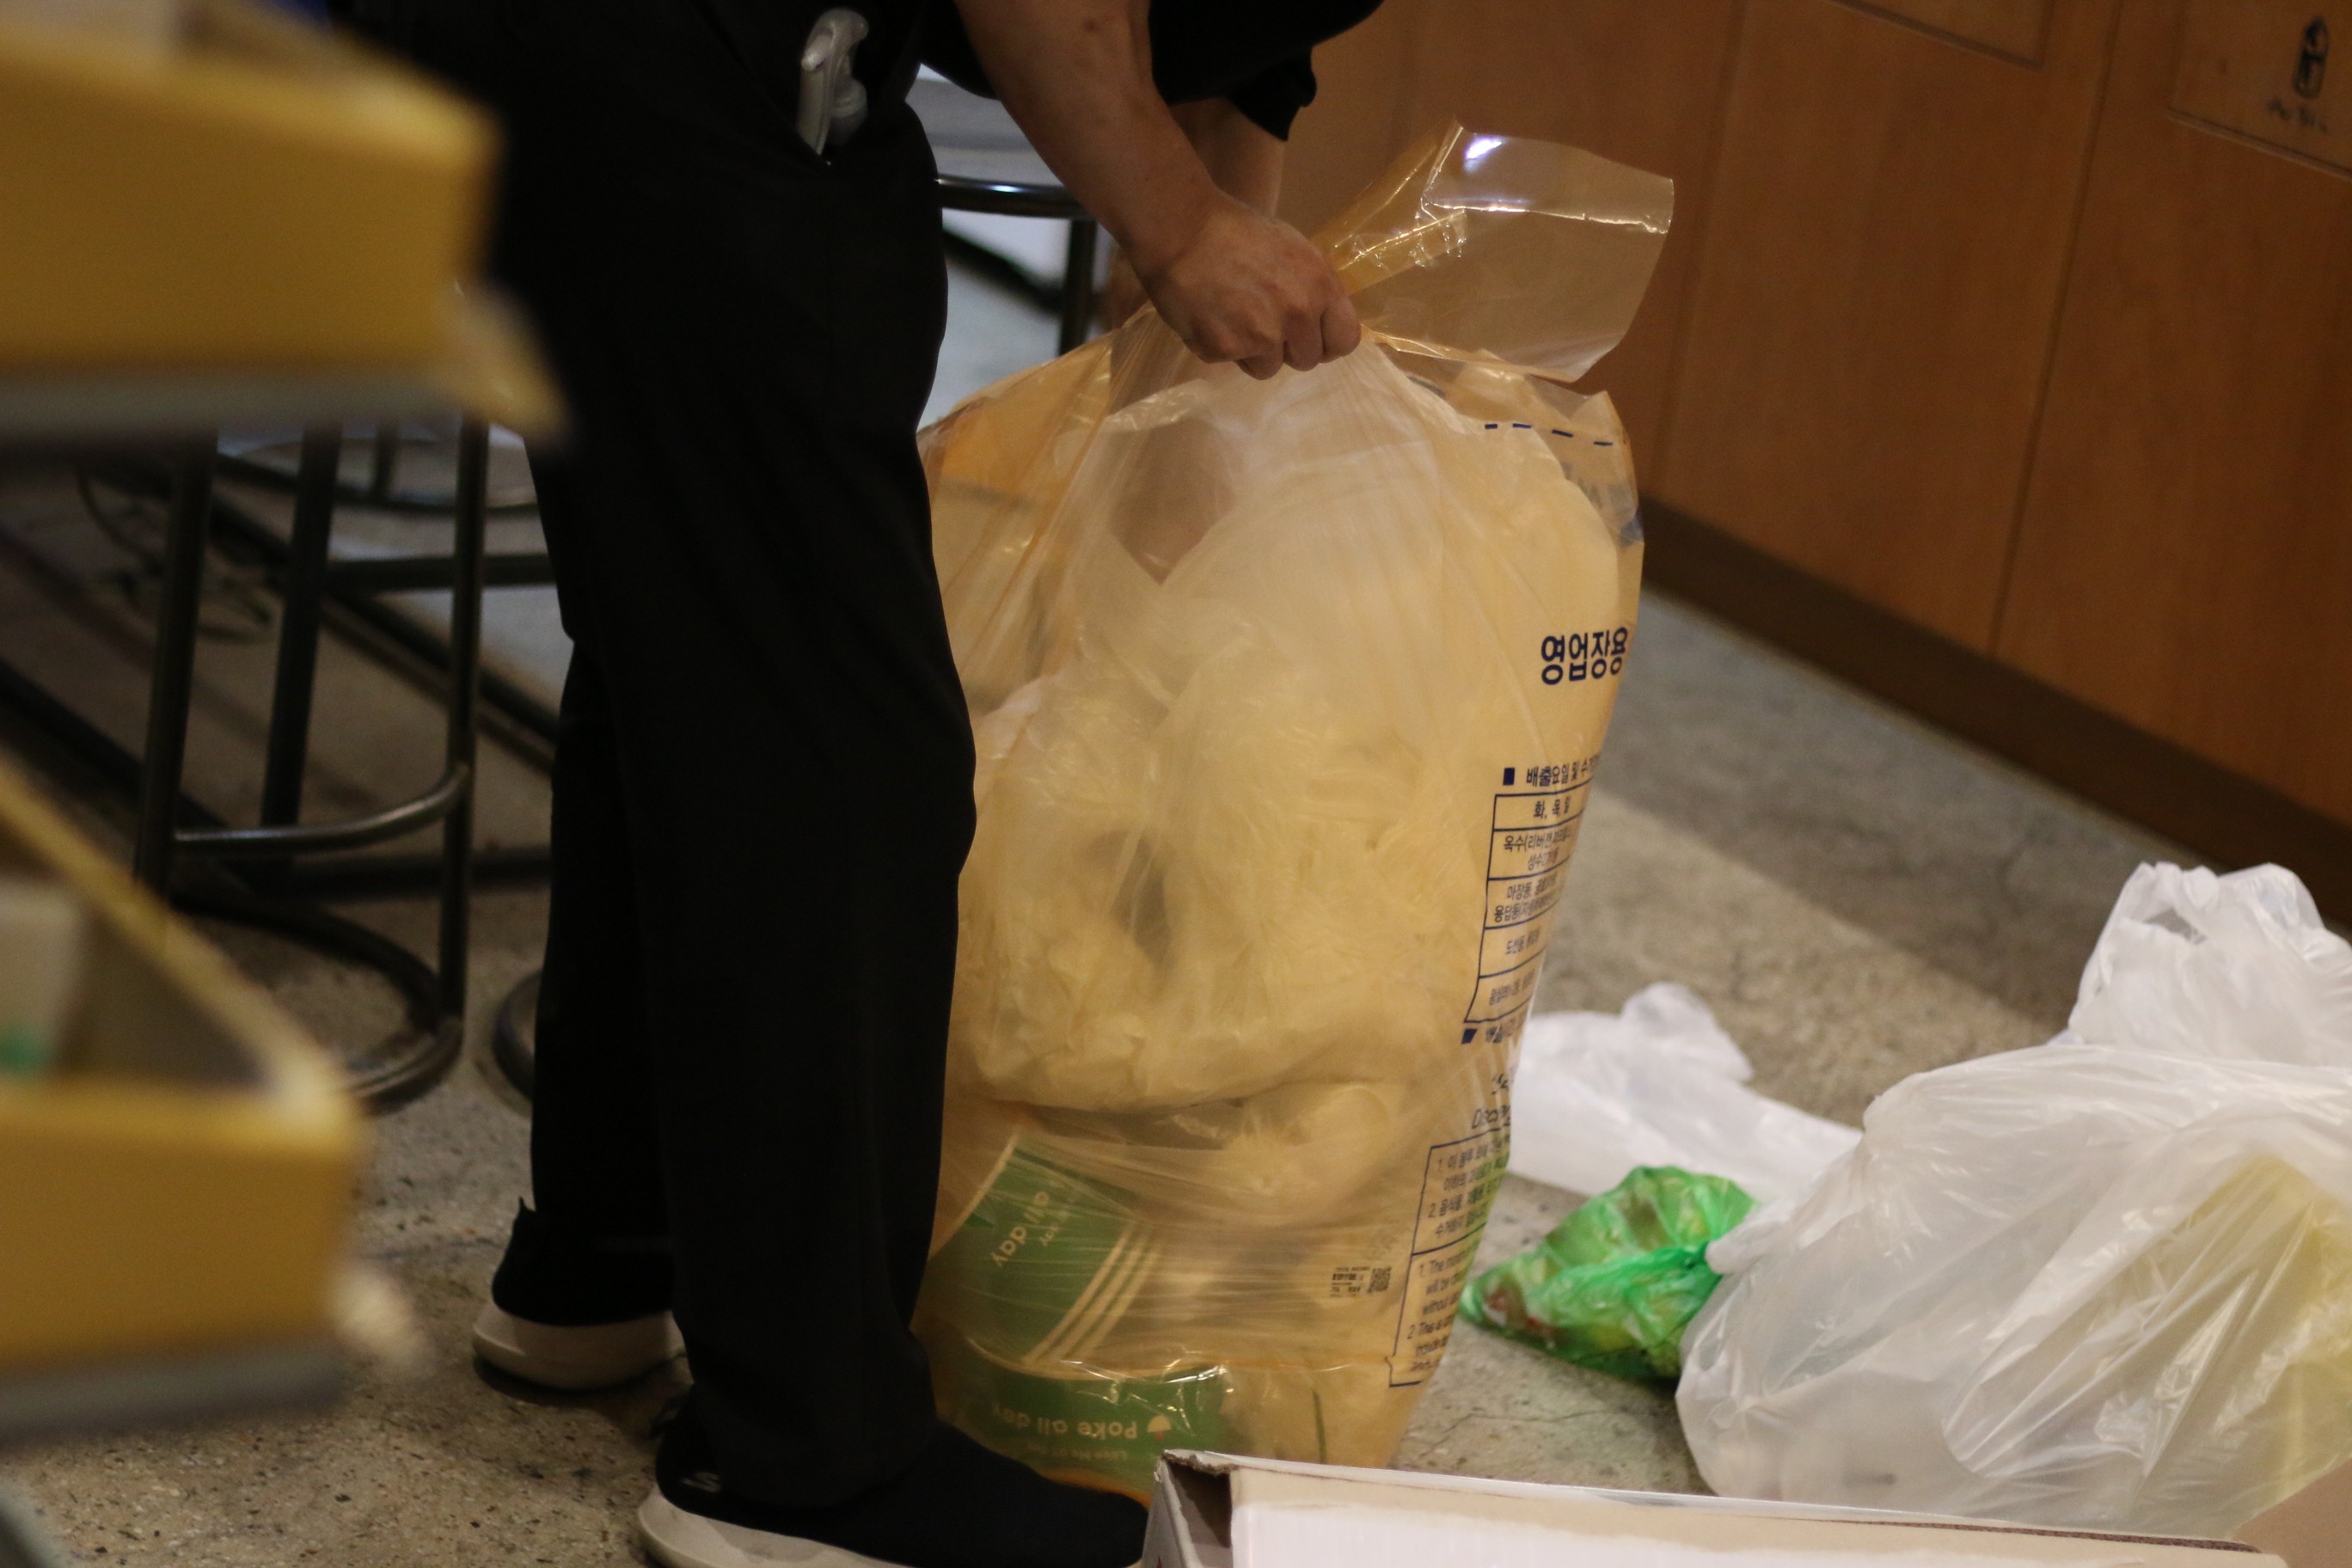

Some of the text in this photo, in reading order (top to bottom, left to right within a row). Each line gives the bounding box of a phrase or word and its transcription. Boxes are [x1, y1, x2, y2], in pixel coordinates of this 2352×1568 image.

[1541, 627, 1628, 685] 영업장용
[1526, 763, 1569, 787] 배출요일
[990, 1226, 1027, 1267] day
[1077, 1420, 1137, 1440] Poke
